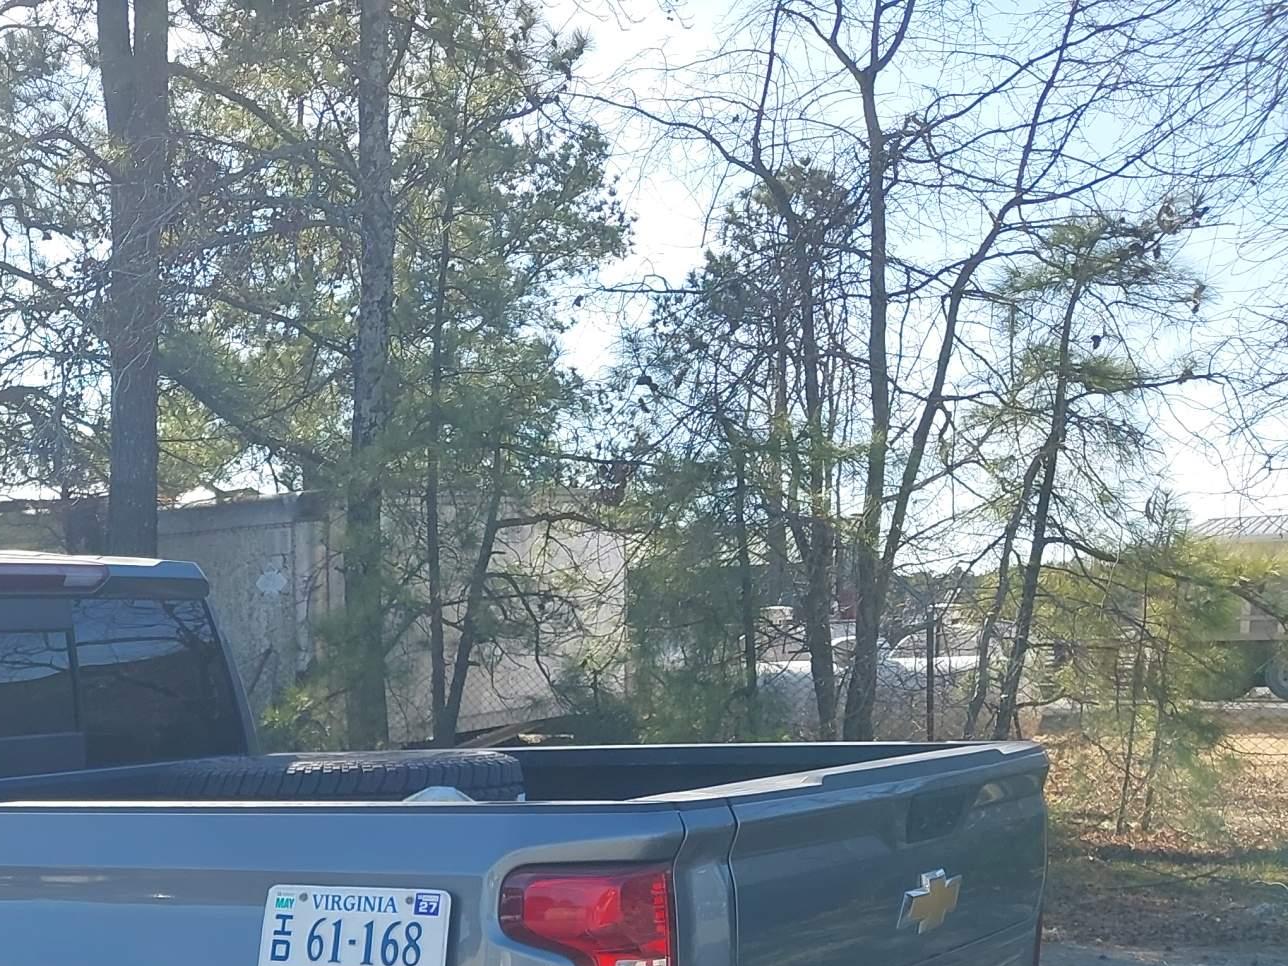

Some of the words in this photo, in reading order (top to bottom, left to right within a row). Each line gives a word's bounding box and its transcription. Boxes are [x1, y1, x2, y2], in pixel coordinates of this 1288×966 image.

[275, 897, 295, 909] MAY
[312, 894, 398, 913] VIRGINIA
[418, 901, 438, 914] 27
